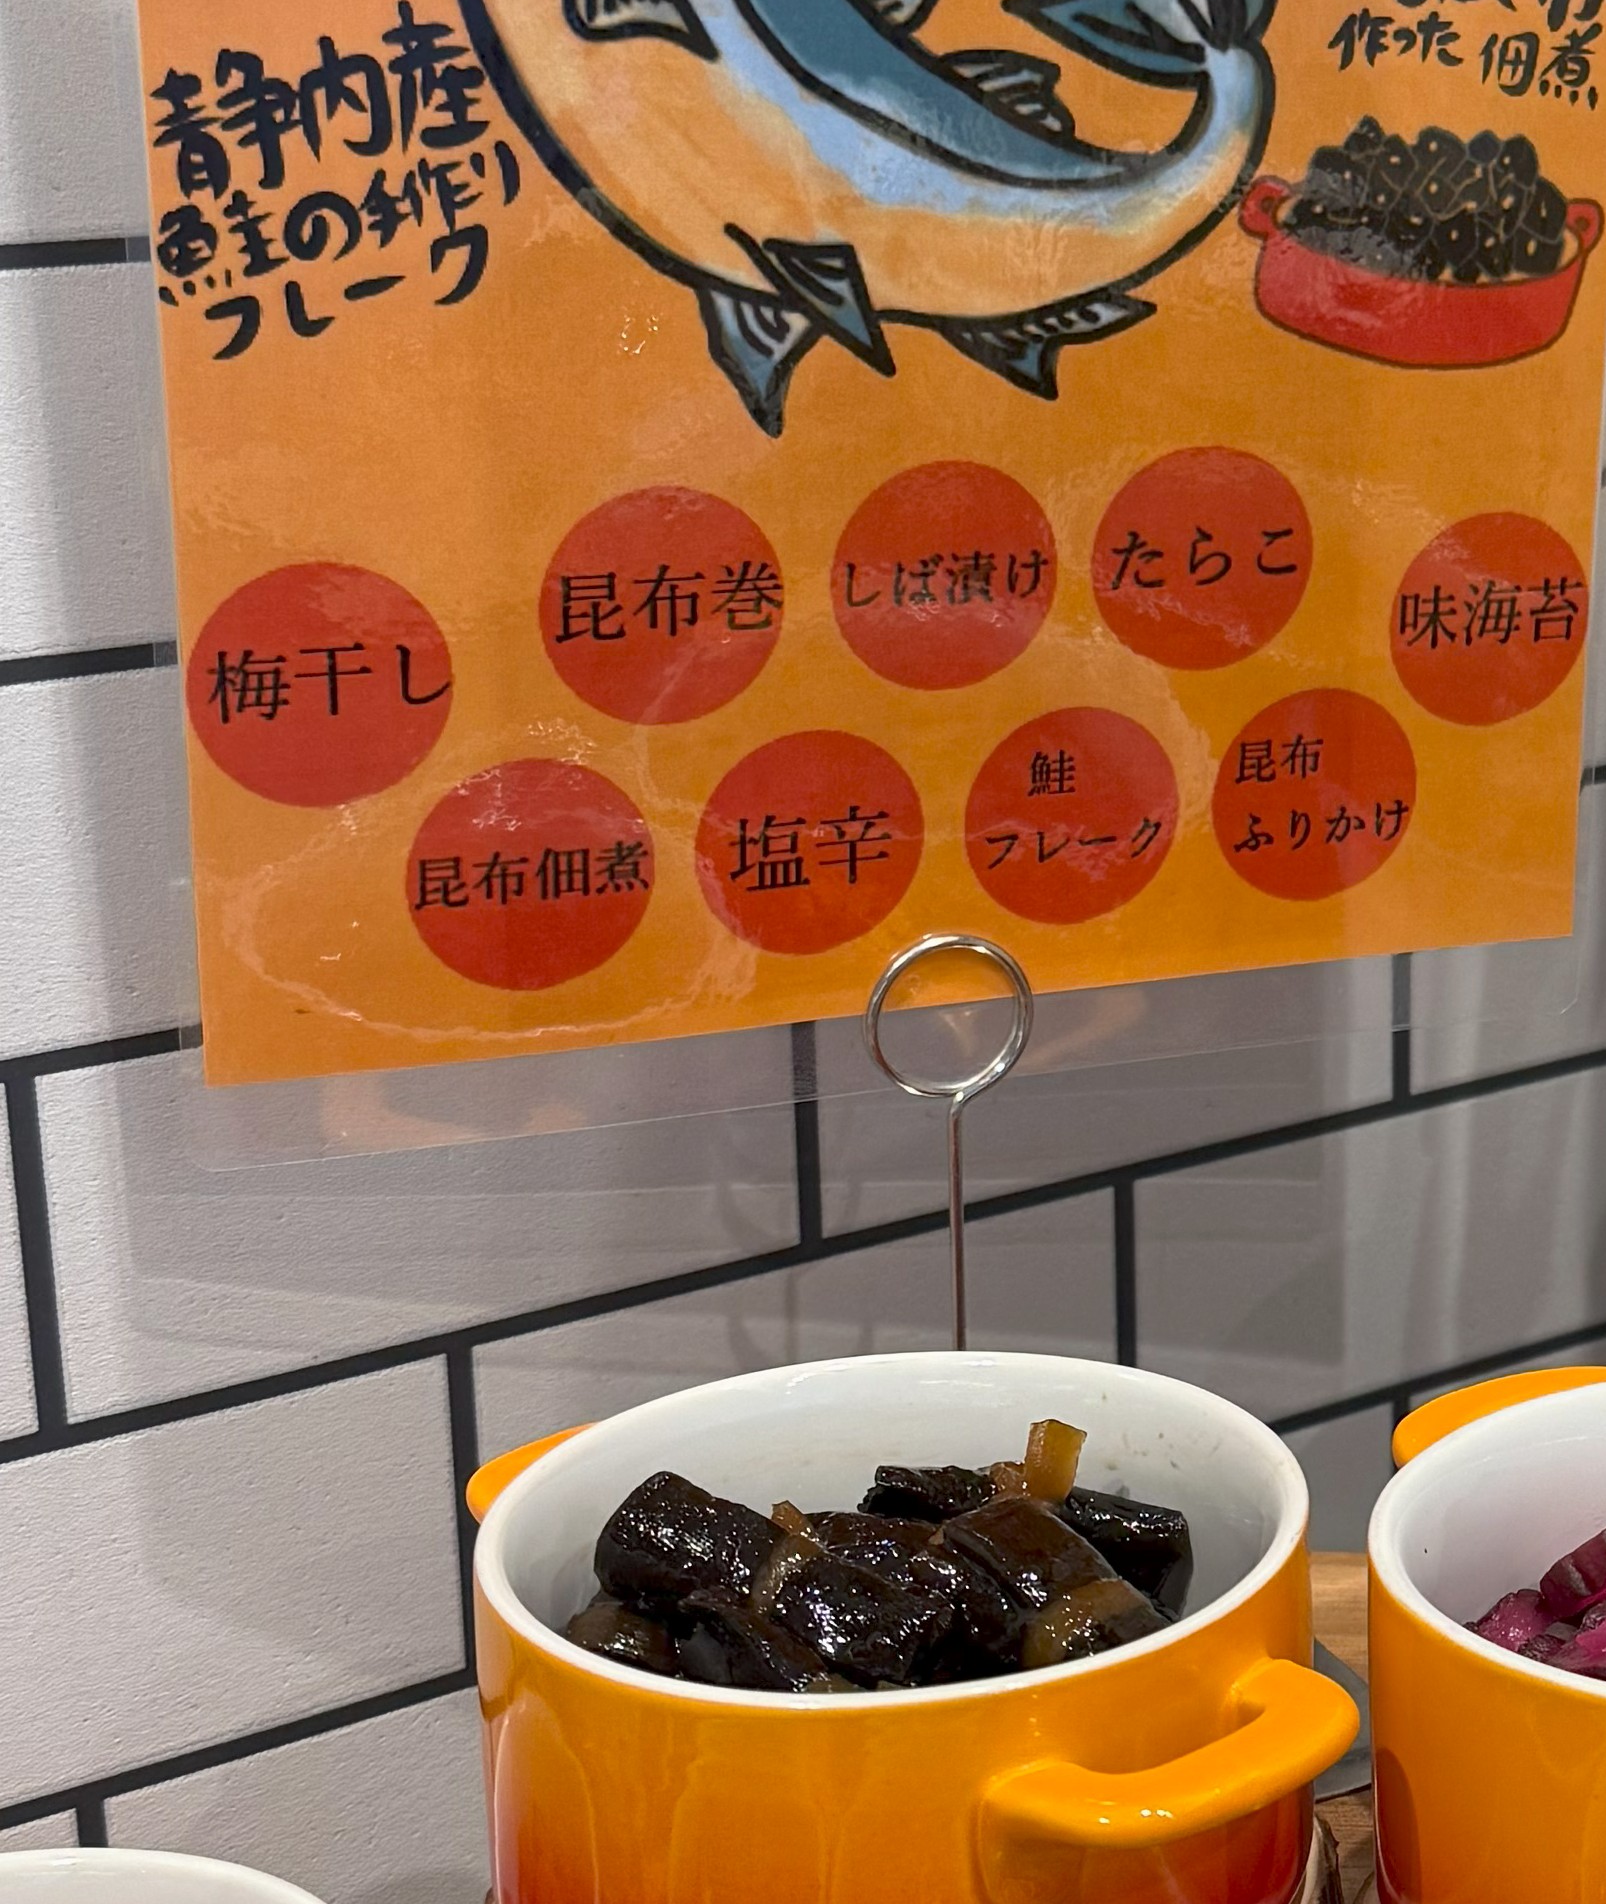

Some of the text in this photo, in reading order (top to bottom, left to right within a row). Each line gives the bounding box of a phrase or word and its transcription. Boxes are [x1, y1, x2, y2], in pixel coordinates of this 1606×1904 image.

[150, 0, 491, 199] 静内産
[157, 141, 520, 306] 鮭の手作り
[205, 224, 489, 360] フレーク
[844, 549, 1050, 609] しば漬け
[1110, 527, 1299, 590] たらこ
[555, 561, 784, 645] 昆布巻
[1399, 578, 1580, 650] 味海苔
[207, 642, 452, 724] 梅干し
[1027, 750, 1077, 797] 鮭
[1236, 733, 1324, 786] 昆布
[729, 805, 891, 893] 塩辛
[985, 816, 1162, 870] フレーク
[1233, 800, 1410, 855] ふりかけ
[415, 840, 651, 911] 昆布佃煮
